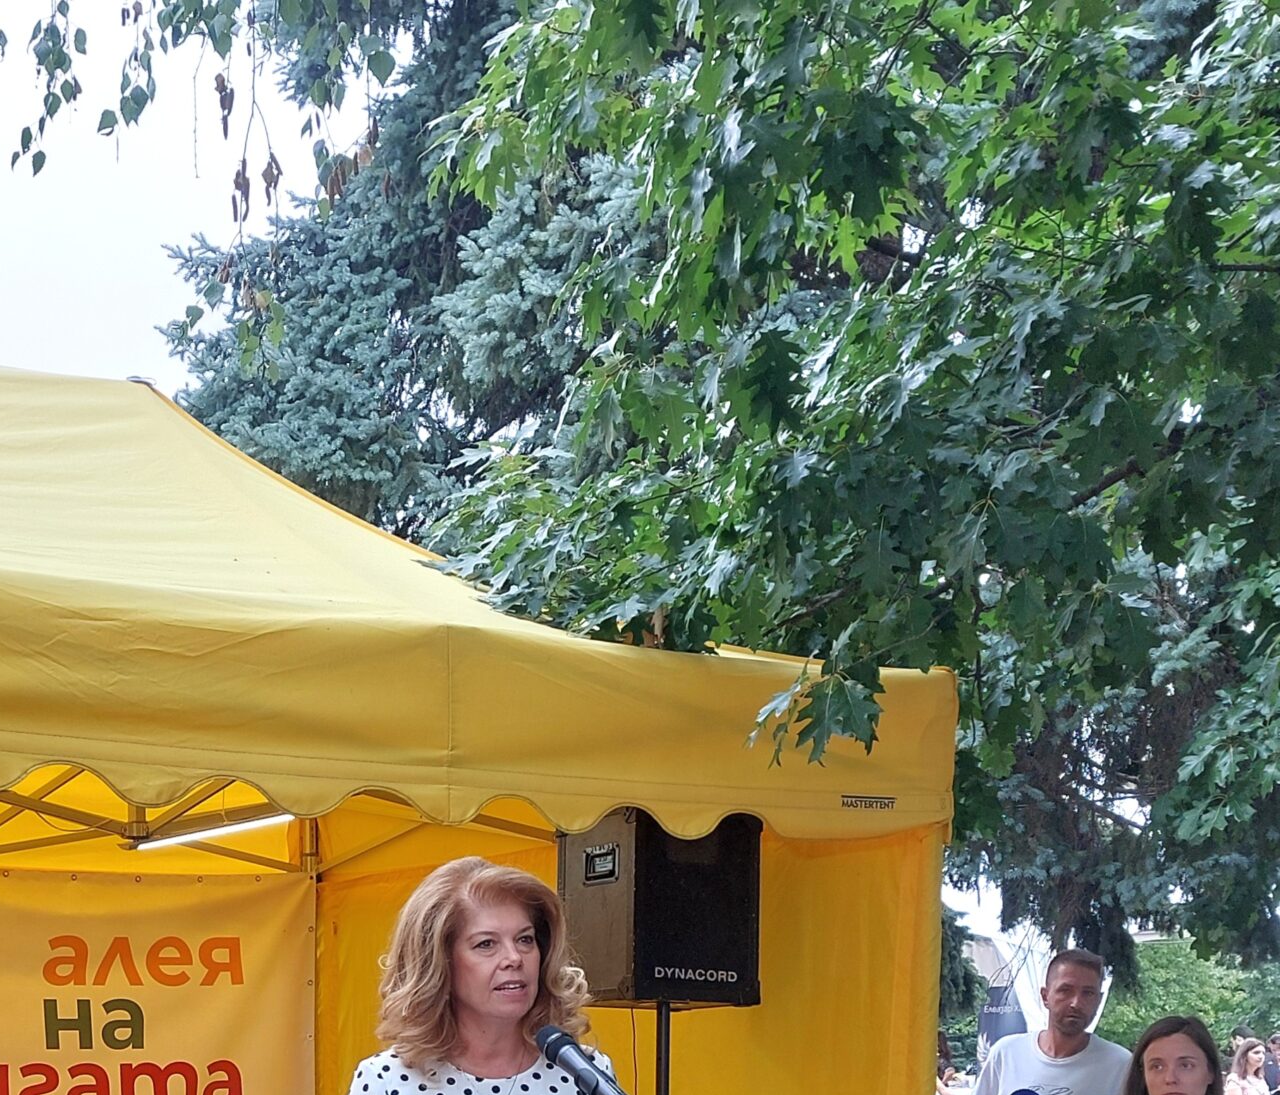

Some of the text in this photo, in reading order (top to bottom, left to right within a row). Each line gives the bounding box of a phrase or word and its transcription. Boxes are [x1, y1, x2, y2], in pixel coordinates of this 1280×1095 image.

[841, 798, 896, 809] MASTERTENT
[42, 935, 245, 986] алея
[654, 967, 738, 983] DYNACORD
[42, 998, 145, 1050] на
